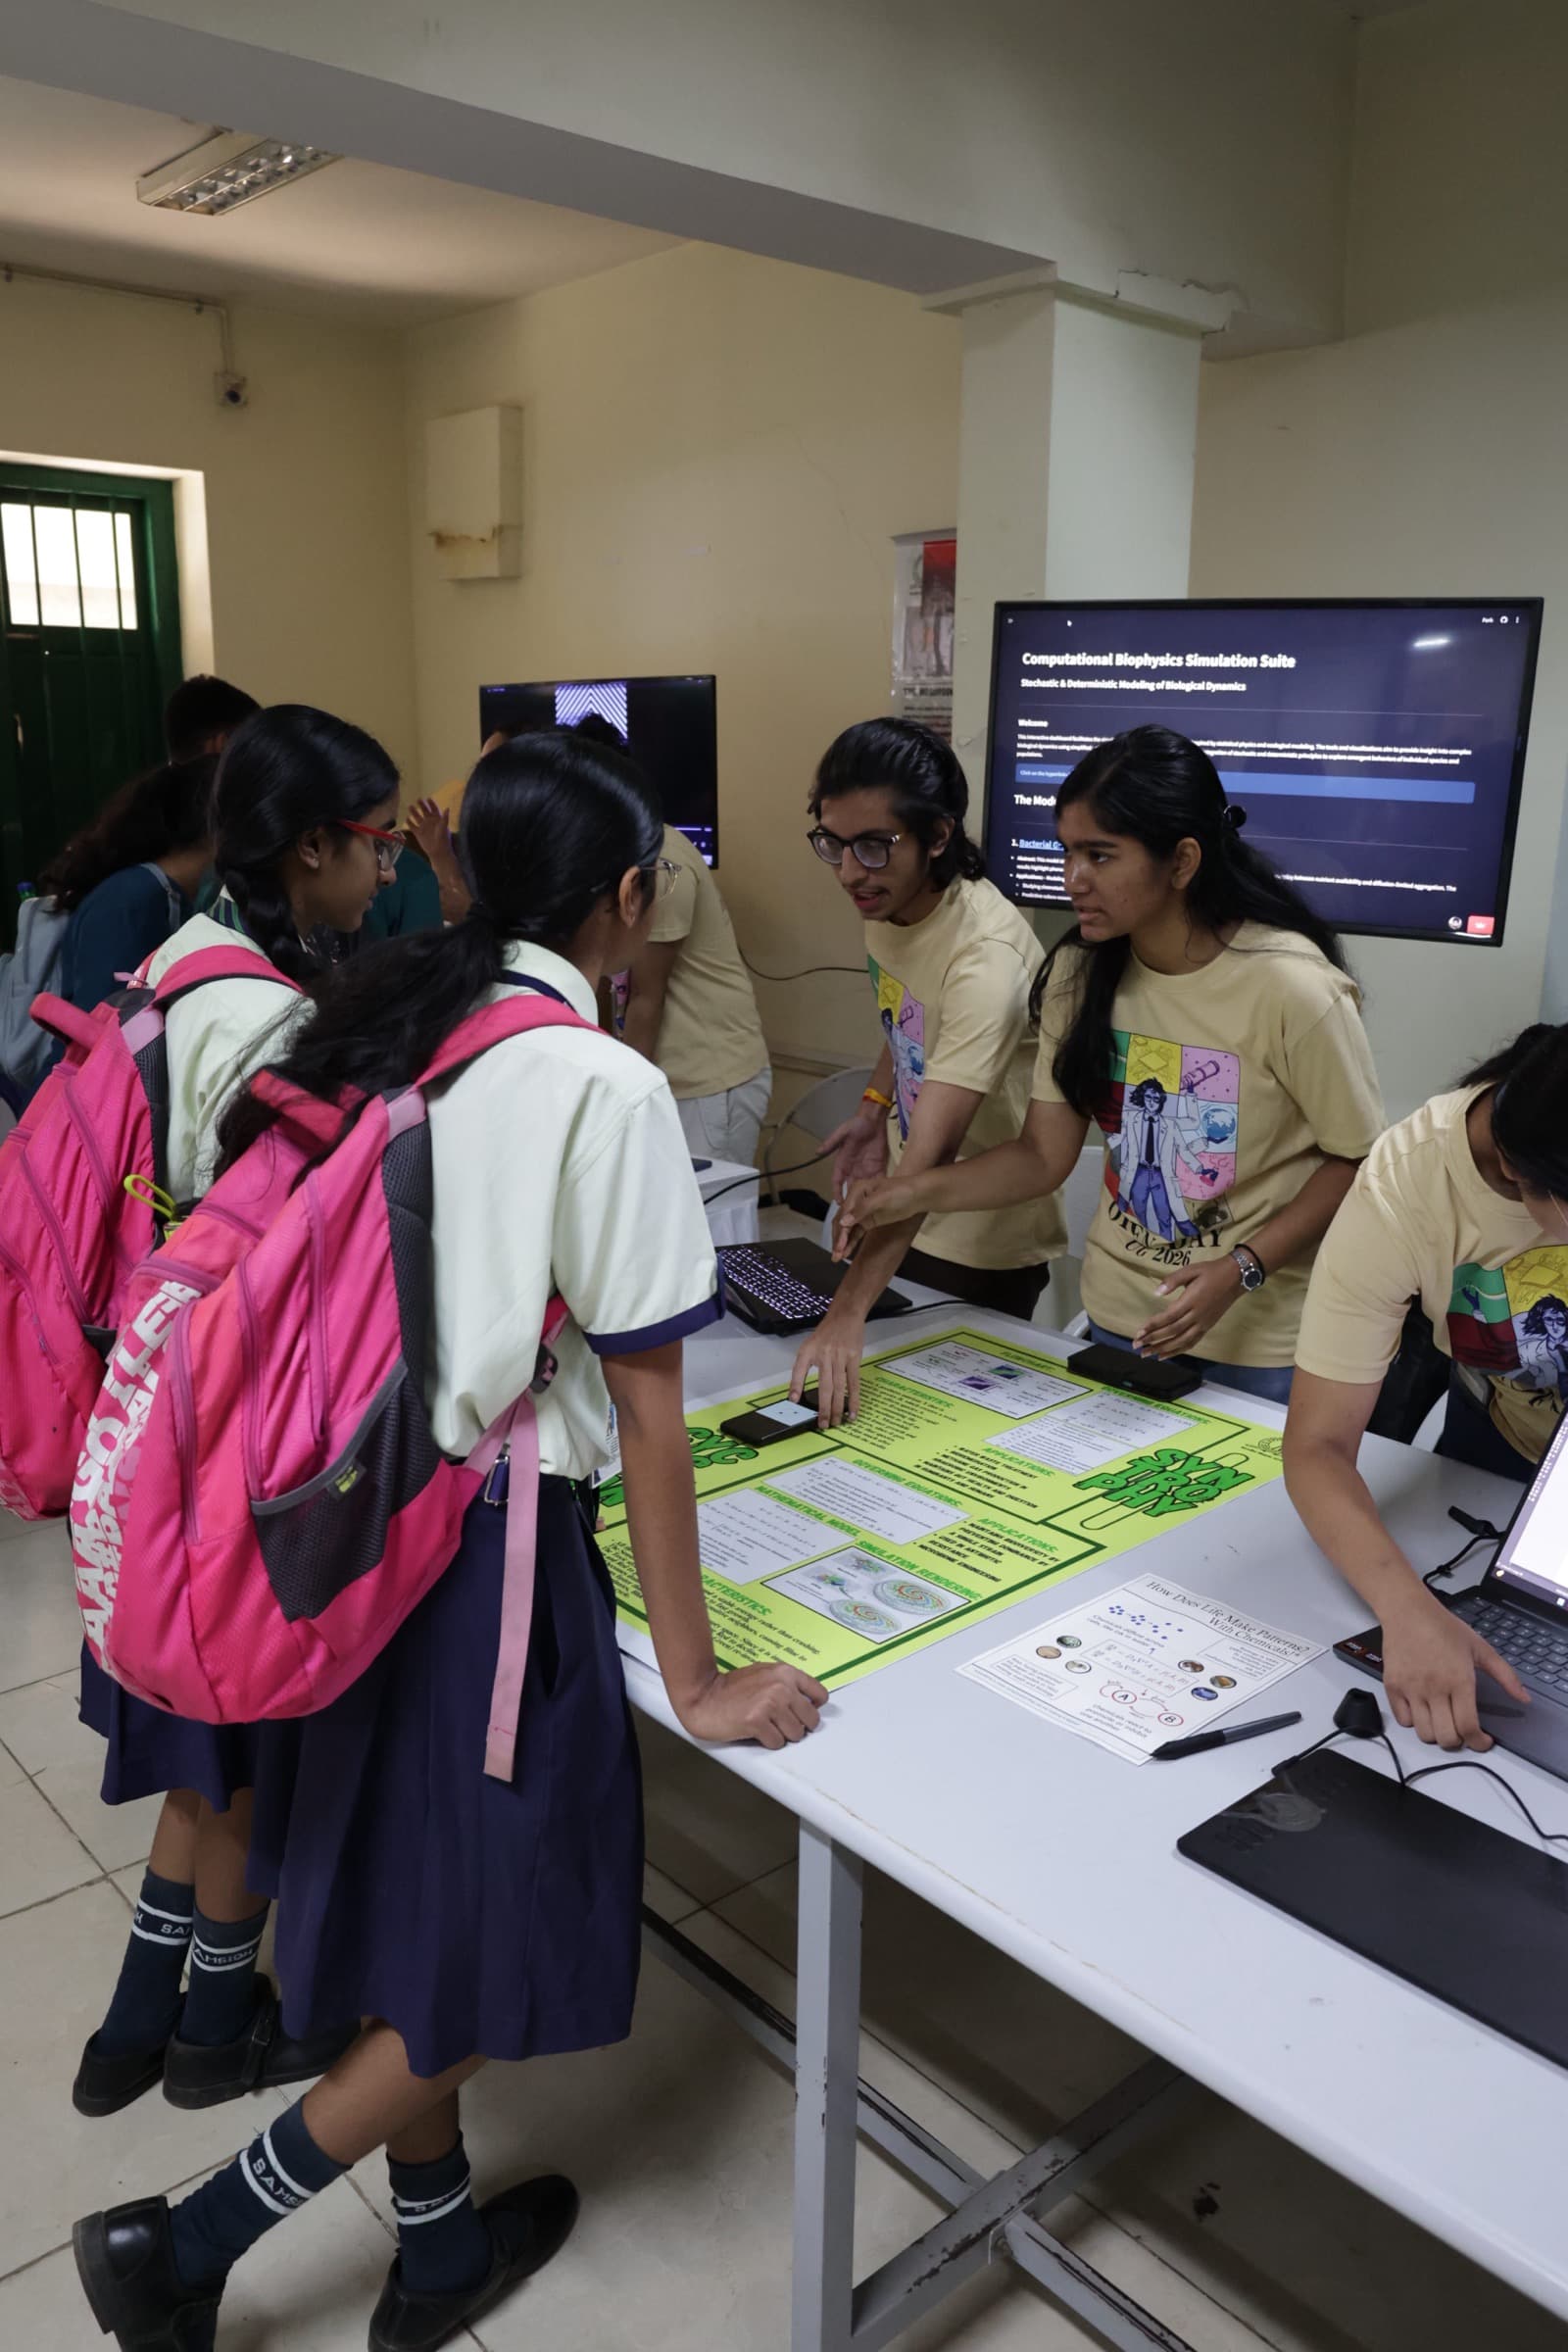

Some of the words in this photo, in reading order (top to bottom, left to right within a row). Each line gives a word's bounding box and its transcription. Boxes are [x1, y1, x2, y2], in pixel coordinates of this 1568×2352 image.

[1022, 653, 1113, 667] Computational
[1115, 654, 1184, 668] Biophysics
[1186, 654, 1257, 667] Simulation
[1260, 655, 1297, 668] Suite
[1021, 678, 1058, 688] Stochastic
[1060, 679, 1066, 688] &
[1067, 679, 1118, 689] Deterministic
[1119, 680, 1155, 691] Modeling
[1156, 680, 1165, 690] of
[1166, 680, 1205, 692] Biological
[1206, 682, 1247, 692] Dynamics
[1014, 795, 1032, 805] The
[1052, 841, 1062, 850] G
[1152, 1245, 1192, 1267] 2026
[1141, 1448, 1255, 1491] SYN
[1113, 1457, 1223, 1503] TRO
[1072, 1473, 1199, 1517] PHY
[1147, 1581, 1173, 1596] How
[1172, 1593, 1200, 1608] Does
[1200, 1603, 1224, 1618] Life
[1224, 1615, 1256, 1633] Make
[1256, 1629, 1311, 1653] Patterns?
[1209, 1617, 1235, 1635] With
